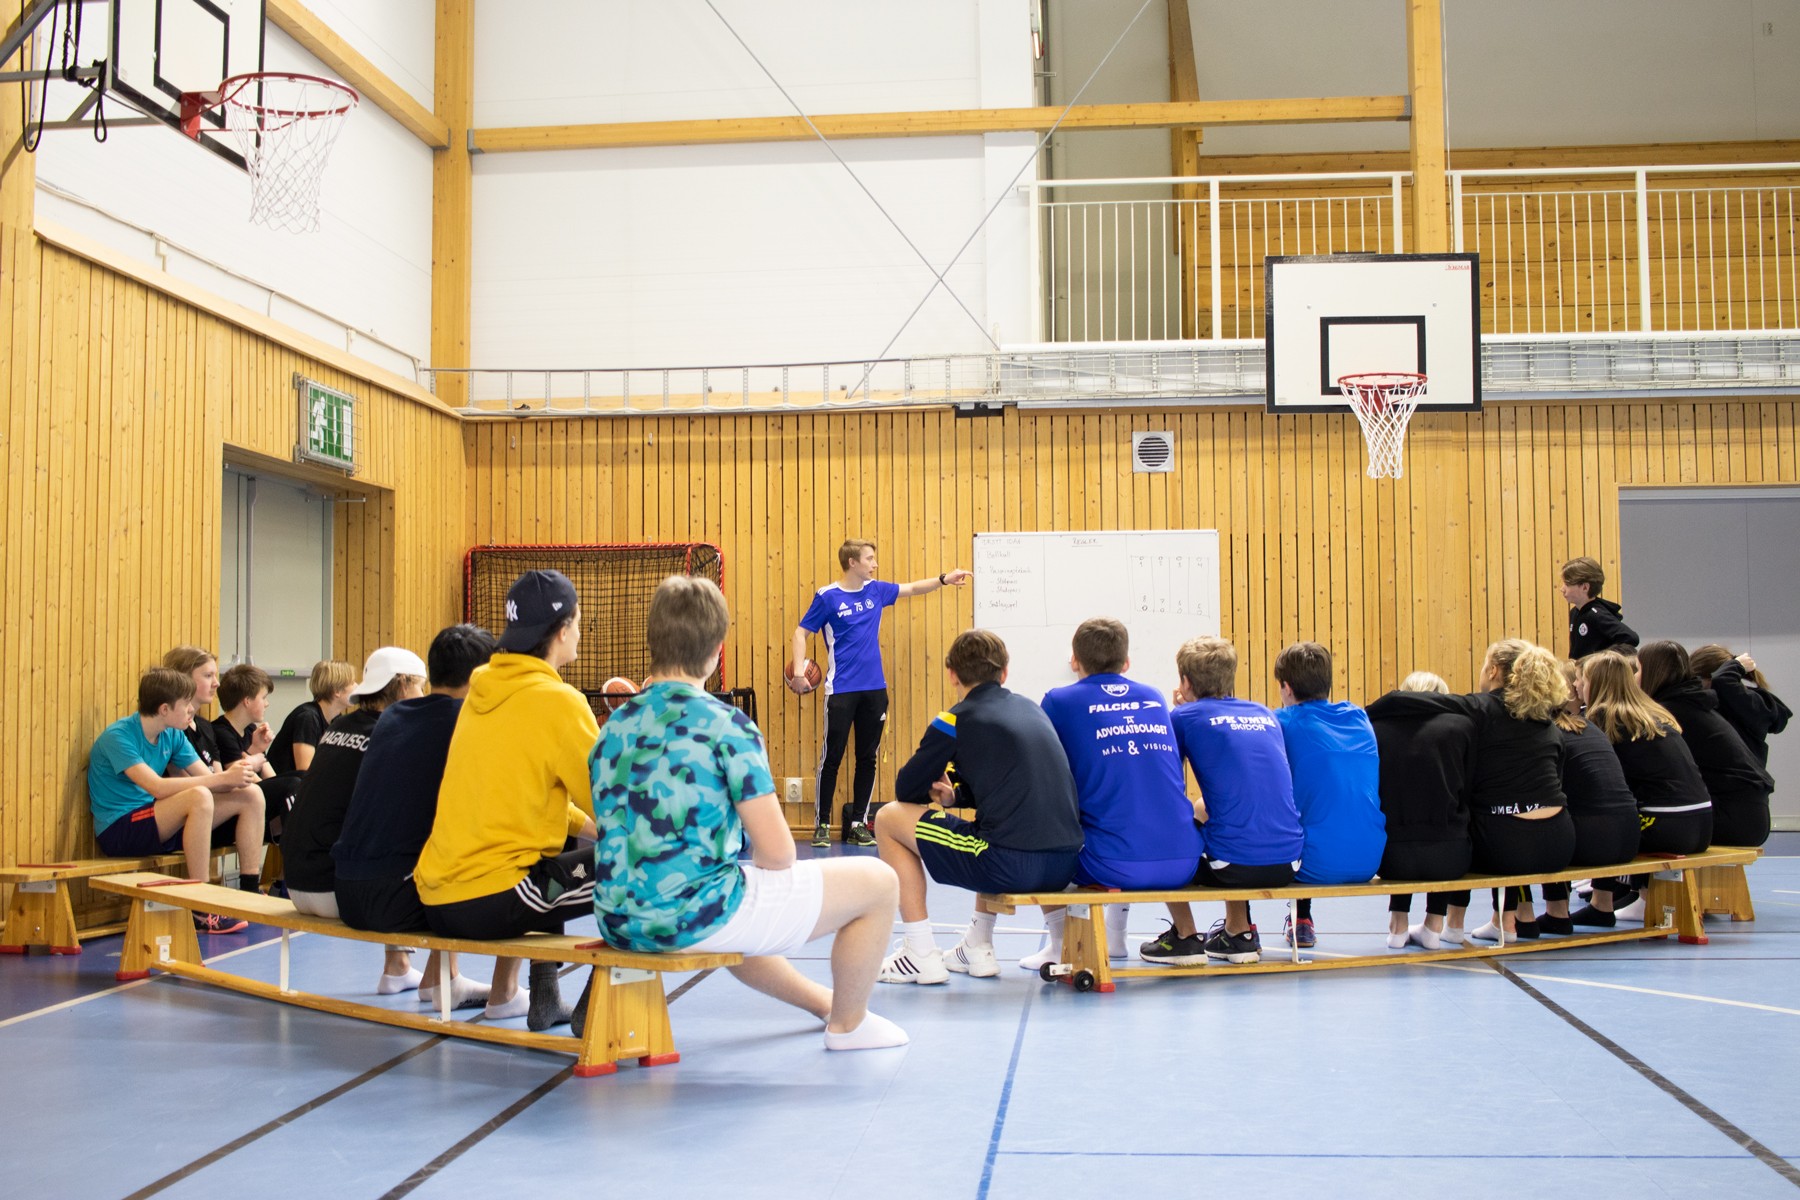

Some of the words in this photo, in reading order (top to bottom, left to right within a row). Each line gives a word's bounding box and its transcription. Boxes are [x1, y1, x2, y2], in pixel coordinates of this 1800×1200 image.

[1089, 702, 1139, 713] FALCKS
[1209, 716, 1237, 726] IFK
[1096, 724, 1167, 739] ADVOKATBOLAGET
[1102, 745, 1123, 756] MÅL
[1128, 740, 1139, 755] &
[1143, 743, 1173, 752] VISION
[1491, 803, 1520, 814] UMEÅ
